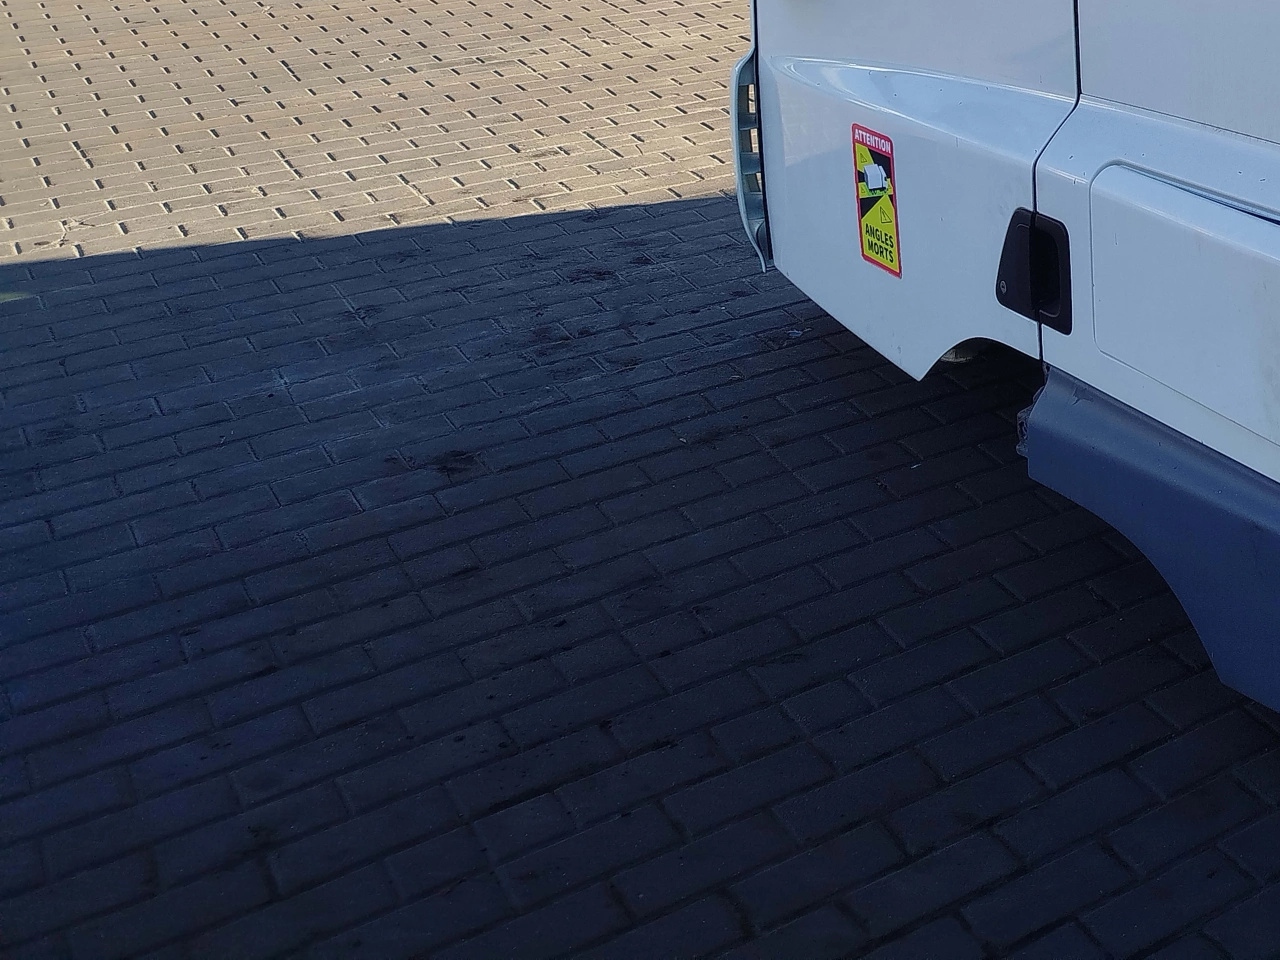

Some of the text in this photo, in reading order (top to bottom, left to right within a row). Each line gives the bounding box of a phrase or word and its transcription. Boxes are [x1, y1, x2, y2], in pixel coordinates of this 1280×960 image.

[854, 129, 892, 154] ATTENTION
[865, 223, 894, 249] ANGLES
[867, 238, 894, 263] MORTS
